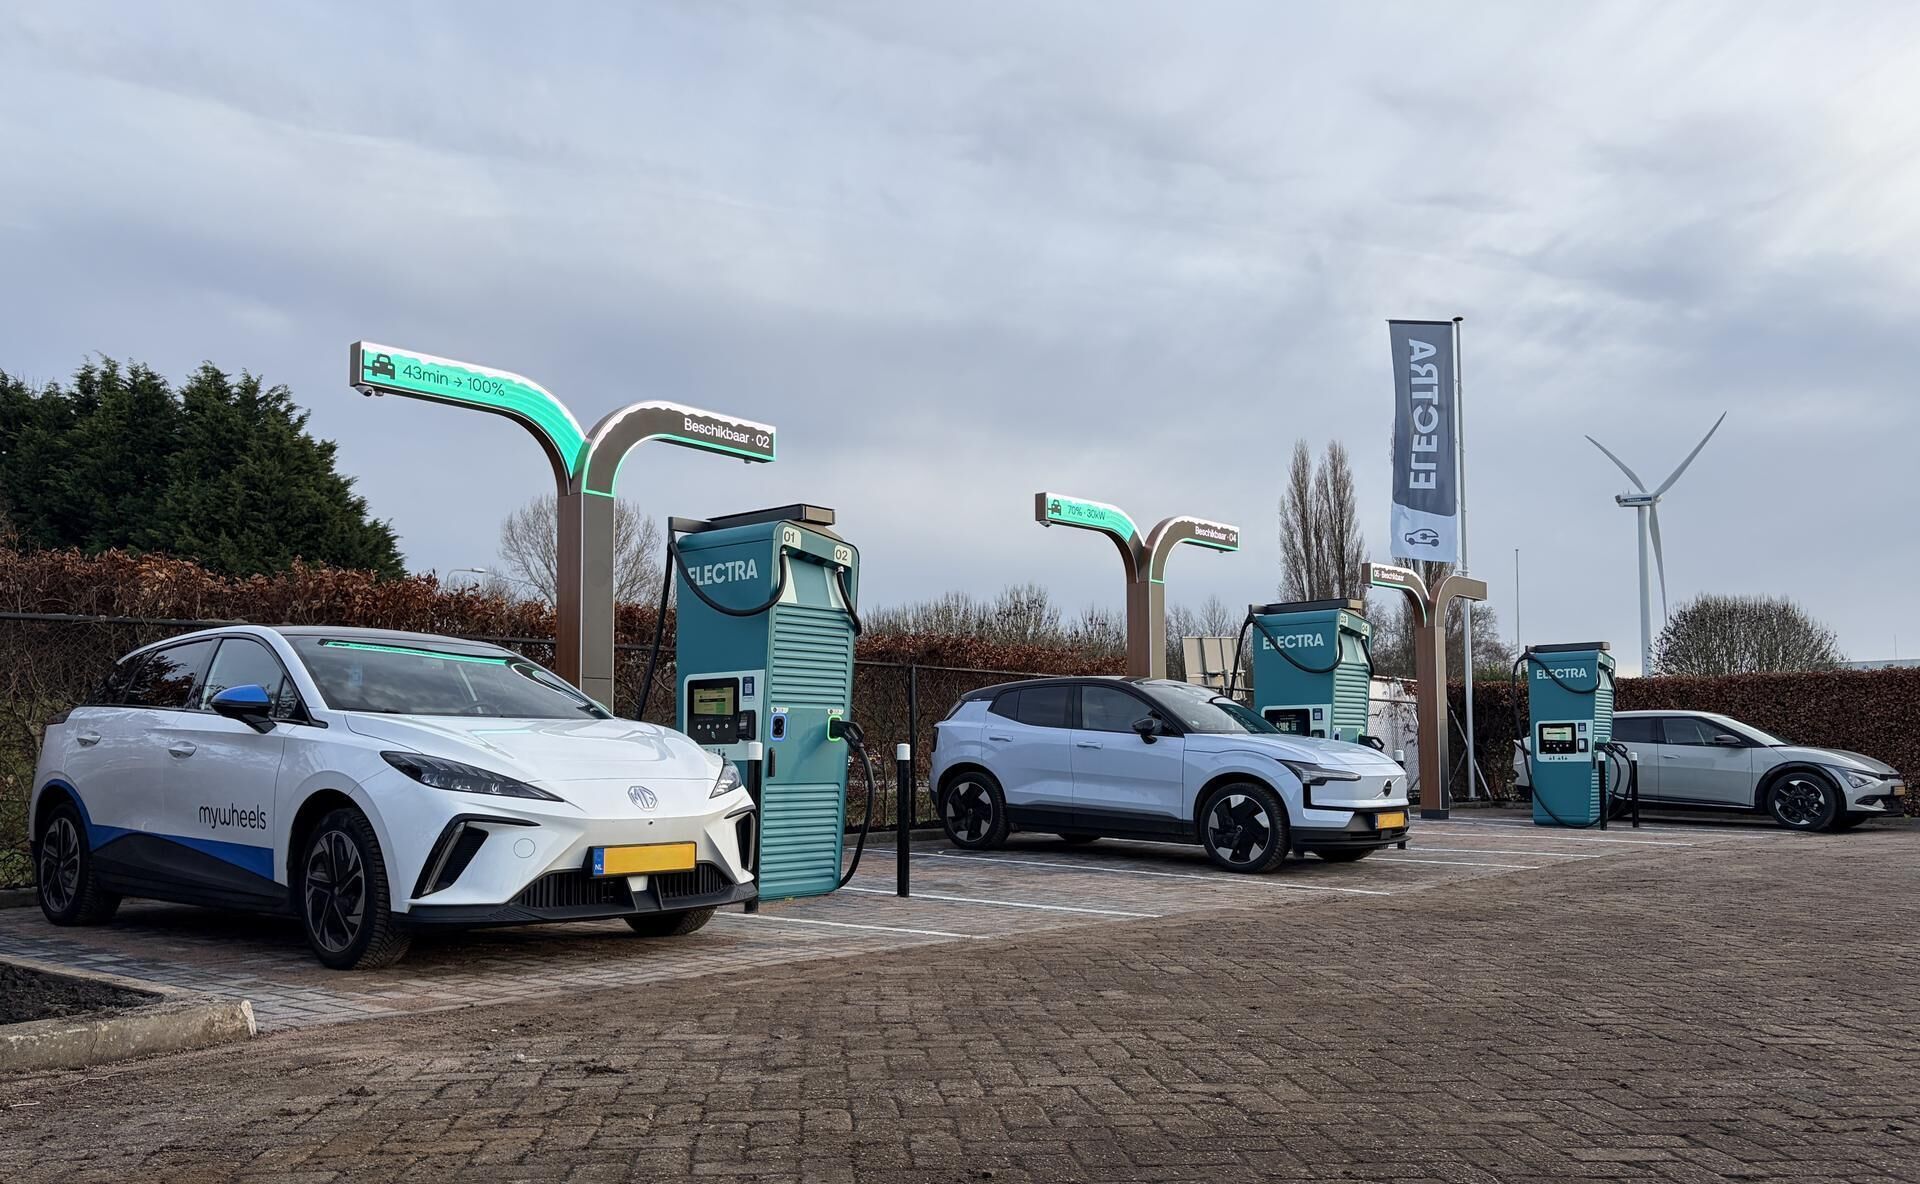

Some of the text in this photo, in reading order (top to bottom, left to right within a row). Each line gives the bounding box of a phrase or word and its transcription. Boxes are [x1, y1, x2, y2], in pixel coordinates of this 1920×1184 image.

[403, 365, 505, 397] 43min 100%
[684, 418, 770, 449] Beschikbaar 02
[1067, 505, 1105, 521] 70% 30kW
[783, 531, 795, 543] 01
[1195, 525, 1227, 541] Beschikbaar
[835, 549, 848, 561] 02
[199, 802, 267, 830] mywheels
